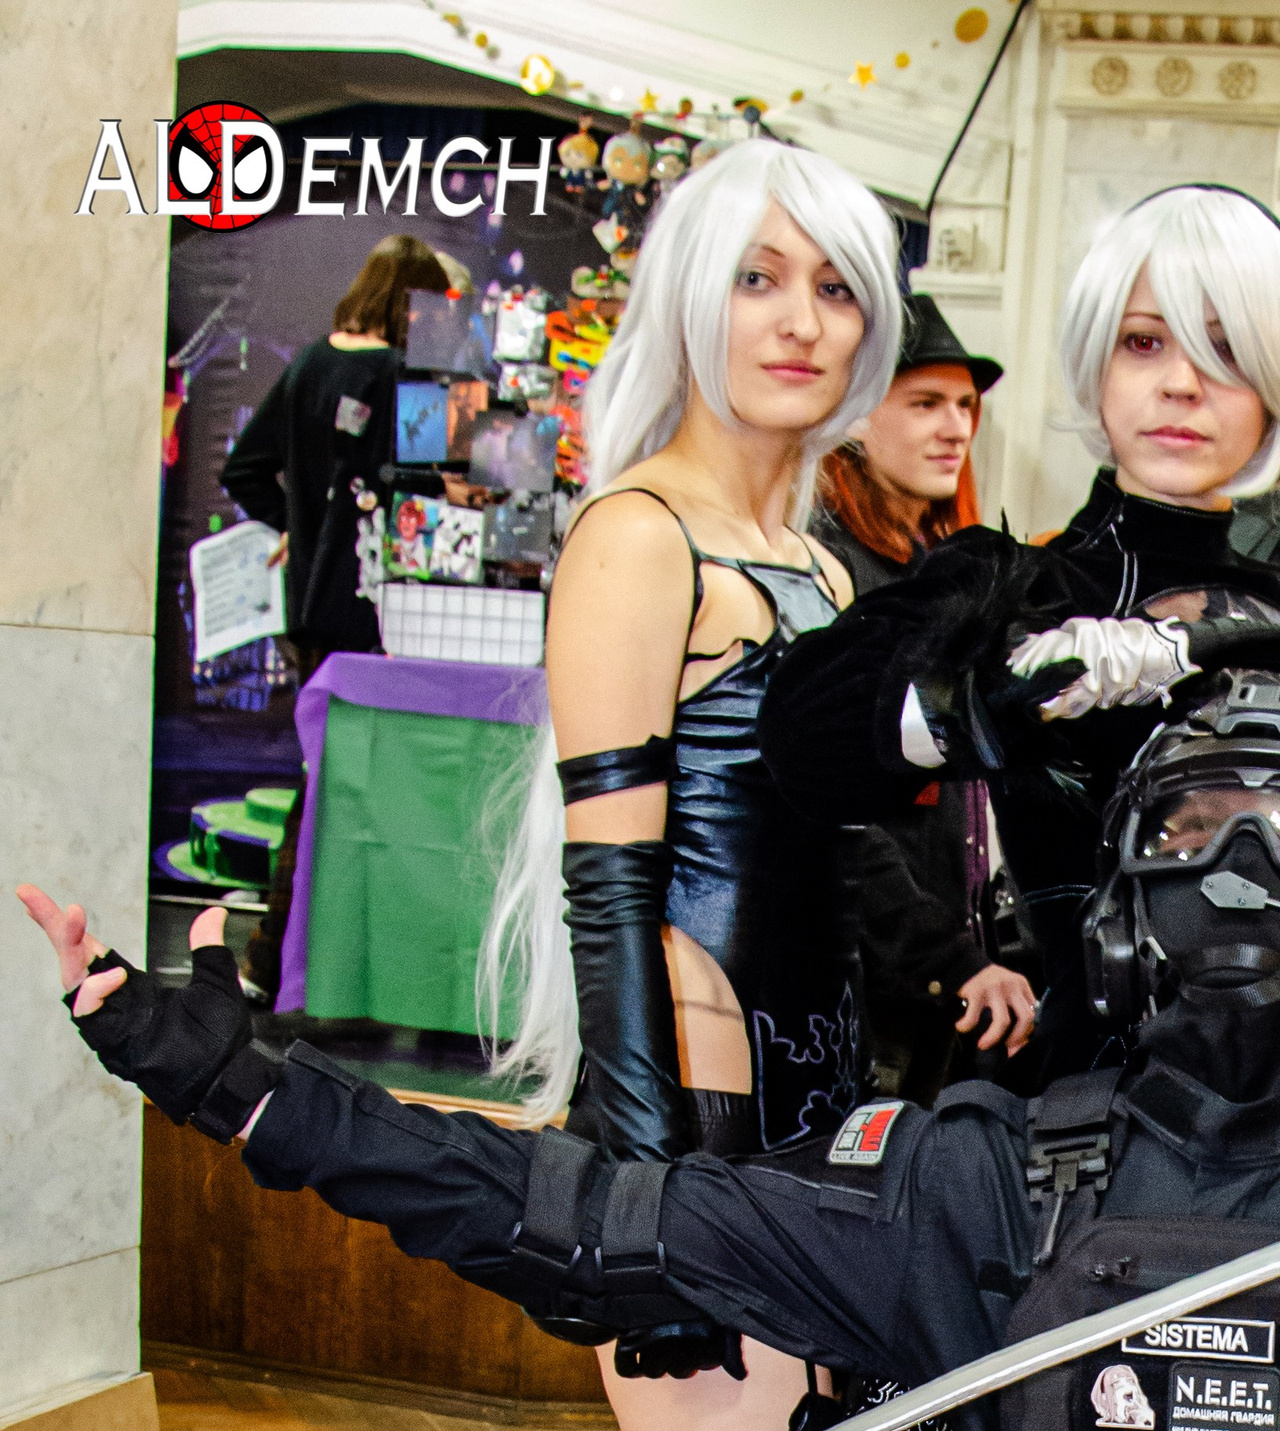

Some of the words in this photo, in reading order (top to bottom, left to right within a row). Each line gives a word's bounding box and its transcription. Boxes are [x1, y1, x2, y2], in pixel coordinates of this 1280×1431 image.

[1144, 1323, 1248, 1352] SISTEMA
[1175, 1375, 1272, 1410] N.E.E.T.
[1172, 1405, 1229, 1422] ДОМАШНЯЯ
[1230, 1411, 1275, 1427] ГВАРДИЯ
